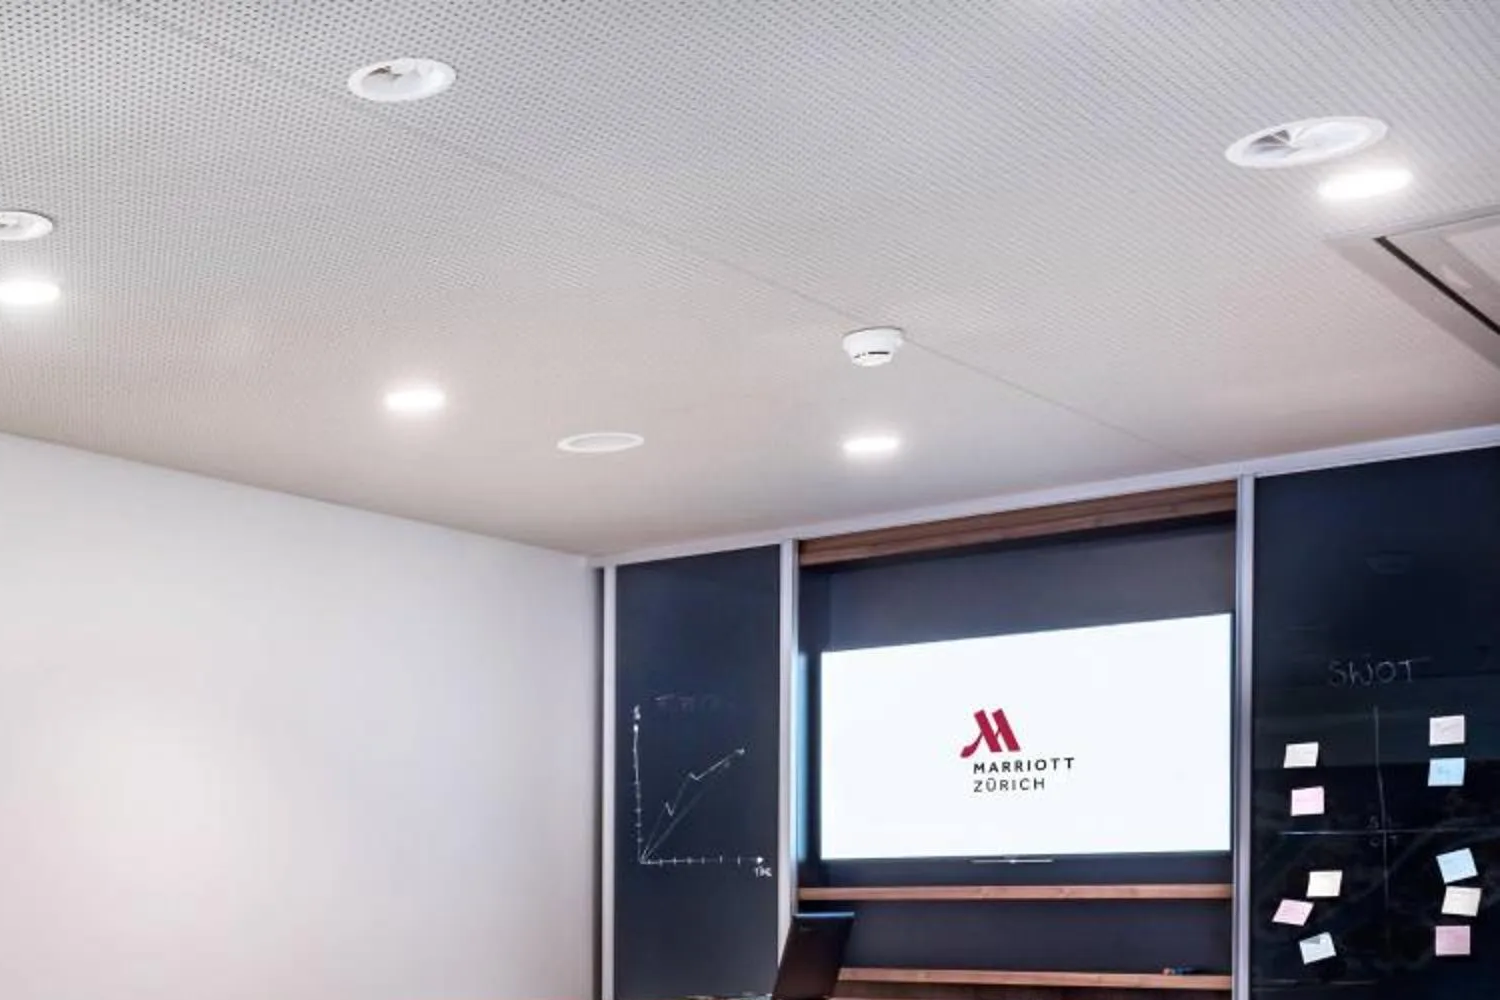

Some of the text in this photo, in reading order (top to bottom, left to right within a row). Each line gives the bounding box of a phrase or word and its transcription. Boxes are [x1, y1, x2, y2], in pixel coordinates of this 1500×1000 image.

[1327, 659, 1424, 688] SWOT
[973, 757, 1075, 774] MARRIOTT
[973, 777, 1045, 793] ZÜRICH
